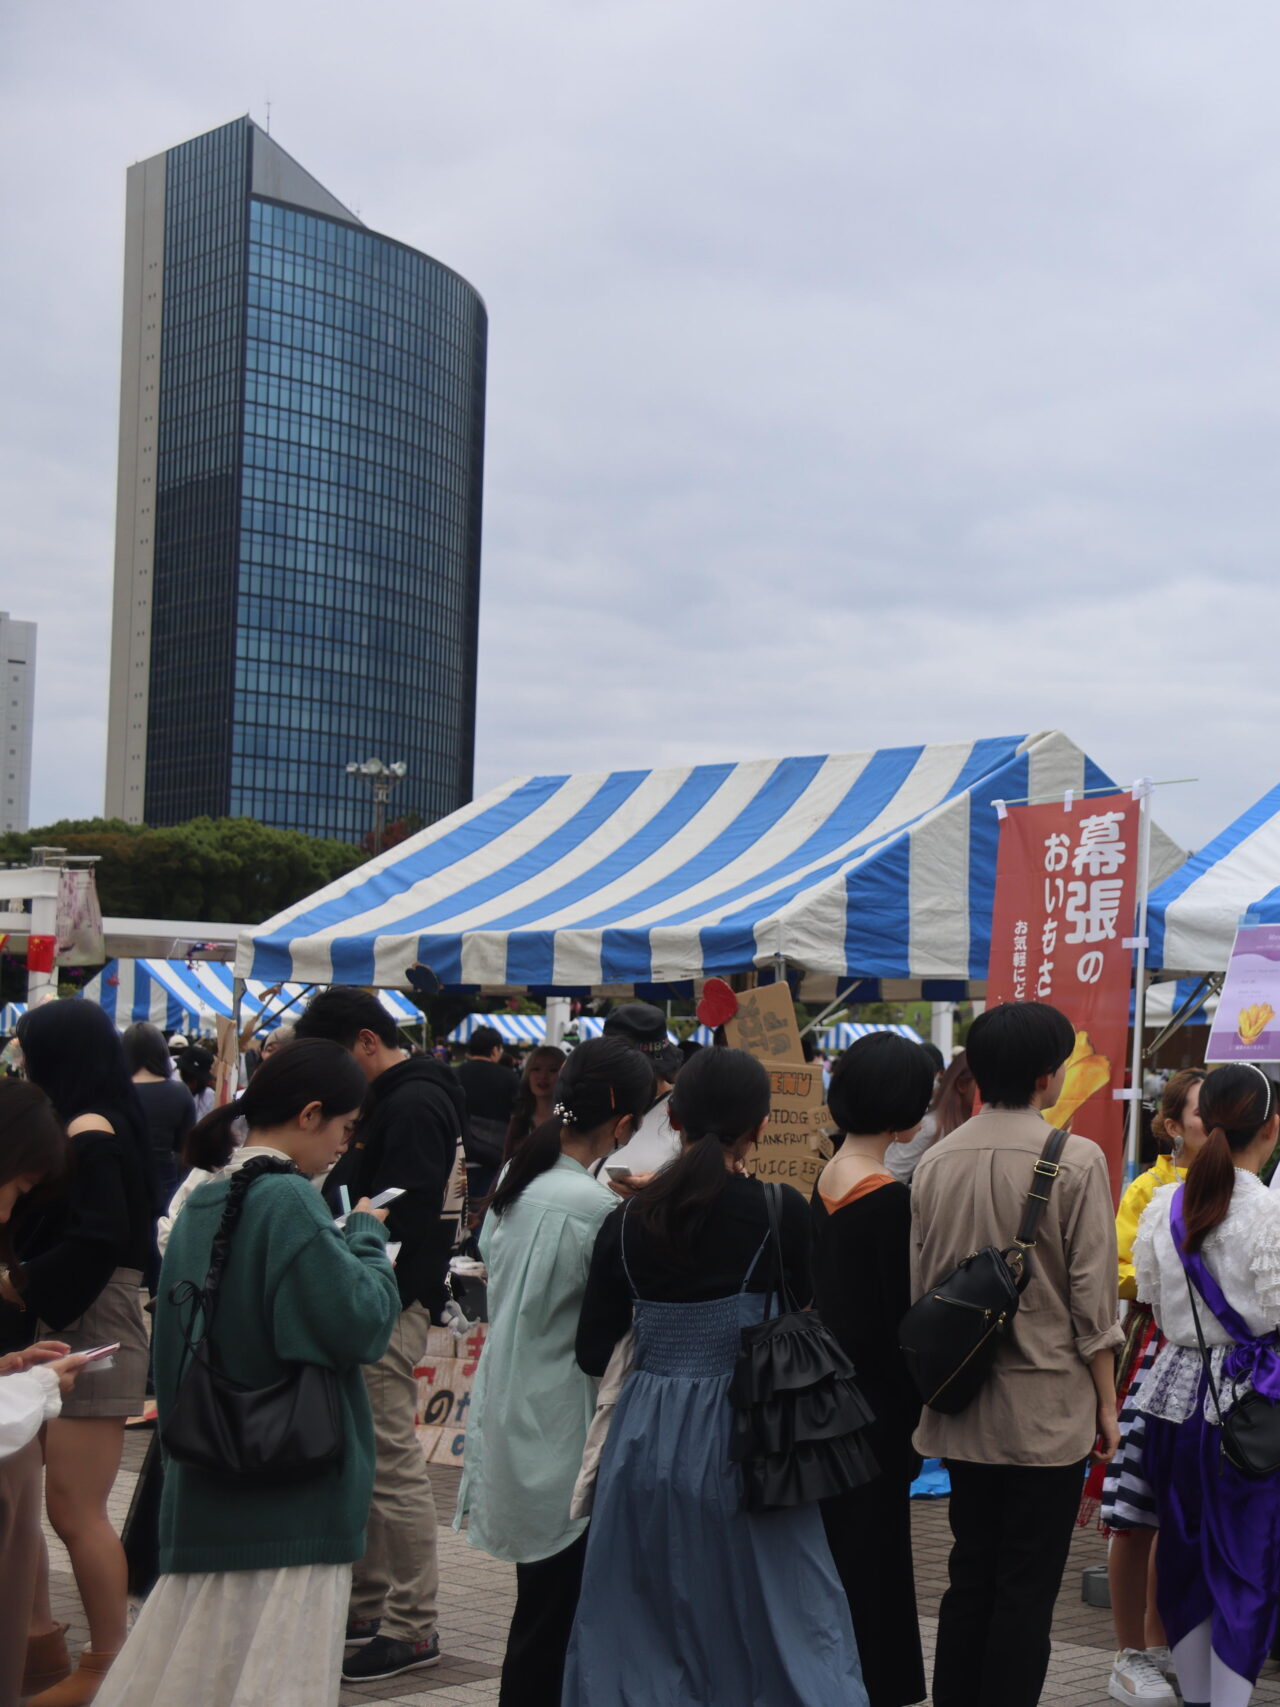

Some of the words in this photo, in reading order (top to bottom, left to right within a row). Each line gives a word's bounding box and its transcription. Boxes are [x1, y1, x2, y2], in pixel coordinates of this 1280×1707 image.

[1037, 832, 1071, 997] おいもさ
[1064, 812, 1126, 984] 幕張の
[1012, 920, 1029, 1001] お気軽にど
[768, 1070, 812, 1097] ENU
[750, 1158, 798, 1177] JUICE
